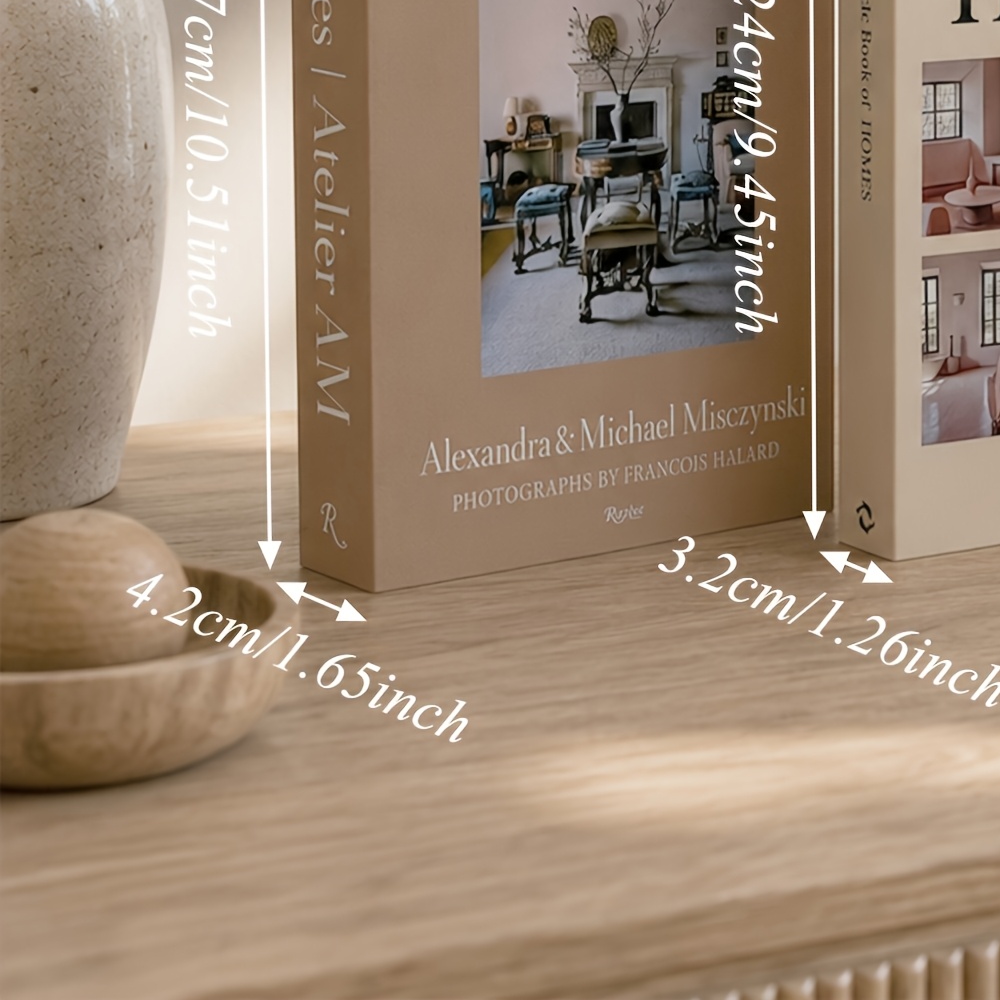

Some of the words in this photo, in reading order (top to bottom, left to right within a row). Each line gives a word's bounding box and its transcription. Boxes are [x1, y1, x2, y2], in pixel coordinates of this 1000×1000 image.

[860, 29, 873, 83] Book
[312, 95, 351, 296] Atelier
[314, 303, 351, 425] AM
[419, 425, 551, 477] Alexandra
[554, 423, 576, 457] &
[580, 402, 676, 453] Michael
[682, 384, 807, 436] Misczynski
[451, 472, 593, 513] PHOTOGRAPHS
[597, 466, 620, 489] BY
[623, 452, 708, 485] FRANCOIS
[712, 440, 782, 469] HALARD
